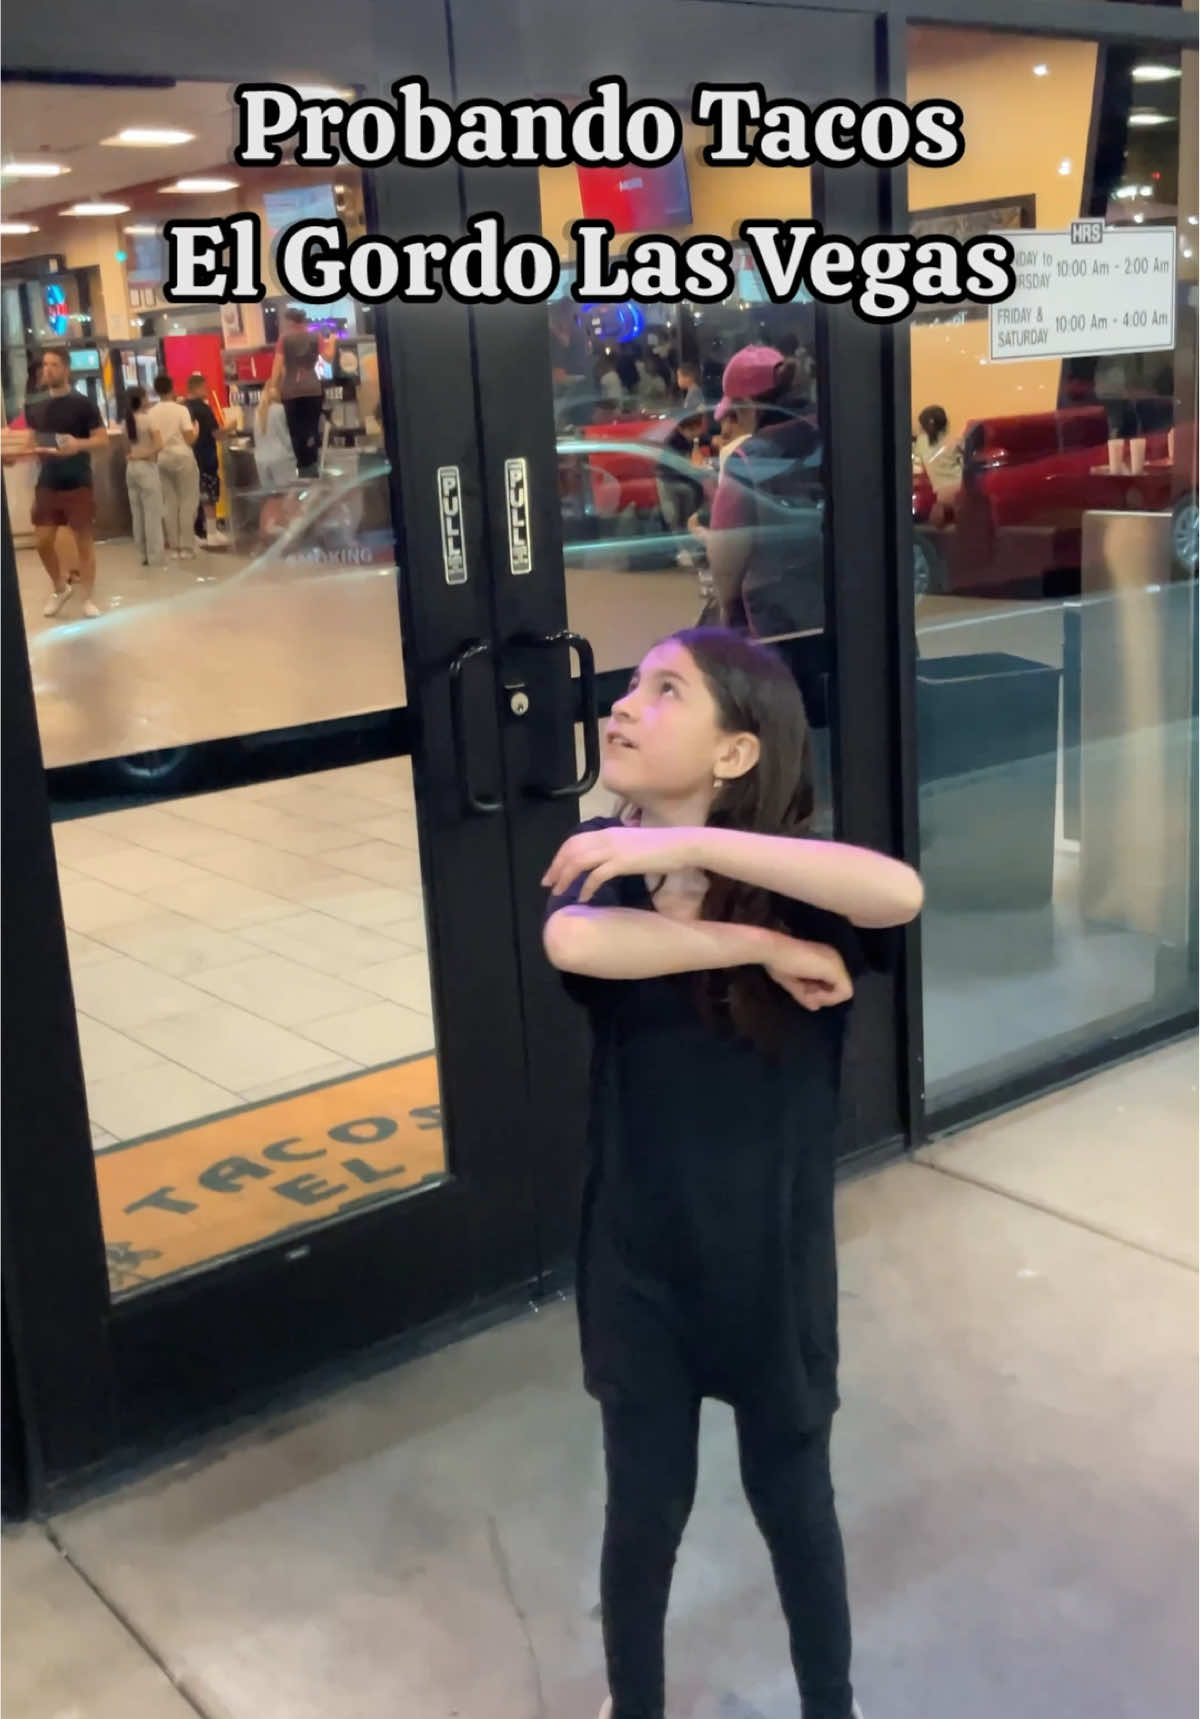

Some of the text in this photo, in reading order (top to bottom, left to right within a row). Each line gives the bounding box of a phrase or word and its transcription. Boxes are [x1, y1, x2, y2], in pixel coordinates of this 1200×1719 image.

[1072, 223, 1102, 243] HRS
[1042, 251, 1053, 267] to
[1056, 259, 1087, 277] 10:00
[1092, 258, 1109, 274] Am
[1124, 256, 1149, 274] 2:00
[1153, 257, 1169, 273] Am
[1017, 272, 1051, 290] RSDAY
[997, 306, 1044, 324] FRIDAY &
[1055, 315, 1086, 333] 10:00
[1091, 313, 1108, 329] Am
[1122, 310, 1148, 328] 4:00
[1152, 309, 1168, 326] Am
[997, 328, 1049, 347] SATURDAY
[441, 476, 461, 556] PULL
[509, 469, 526, 547] PULL
[269, 1157, 406, 1207] EL
